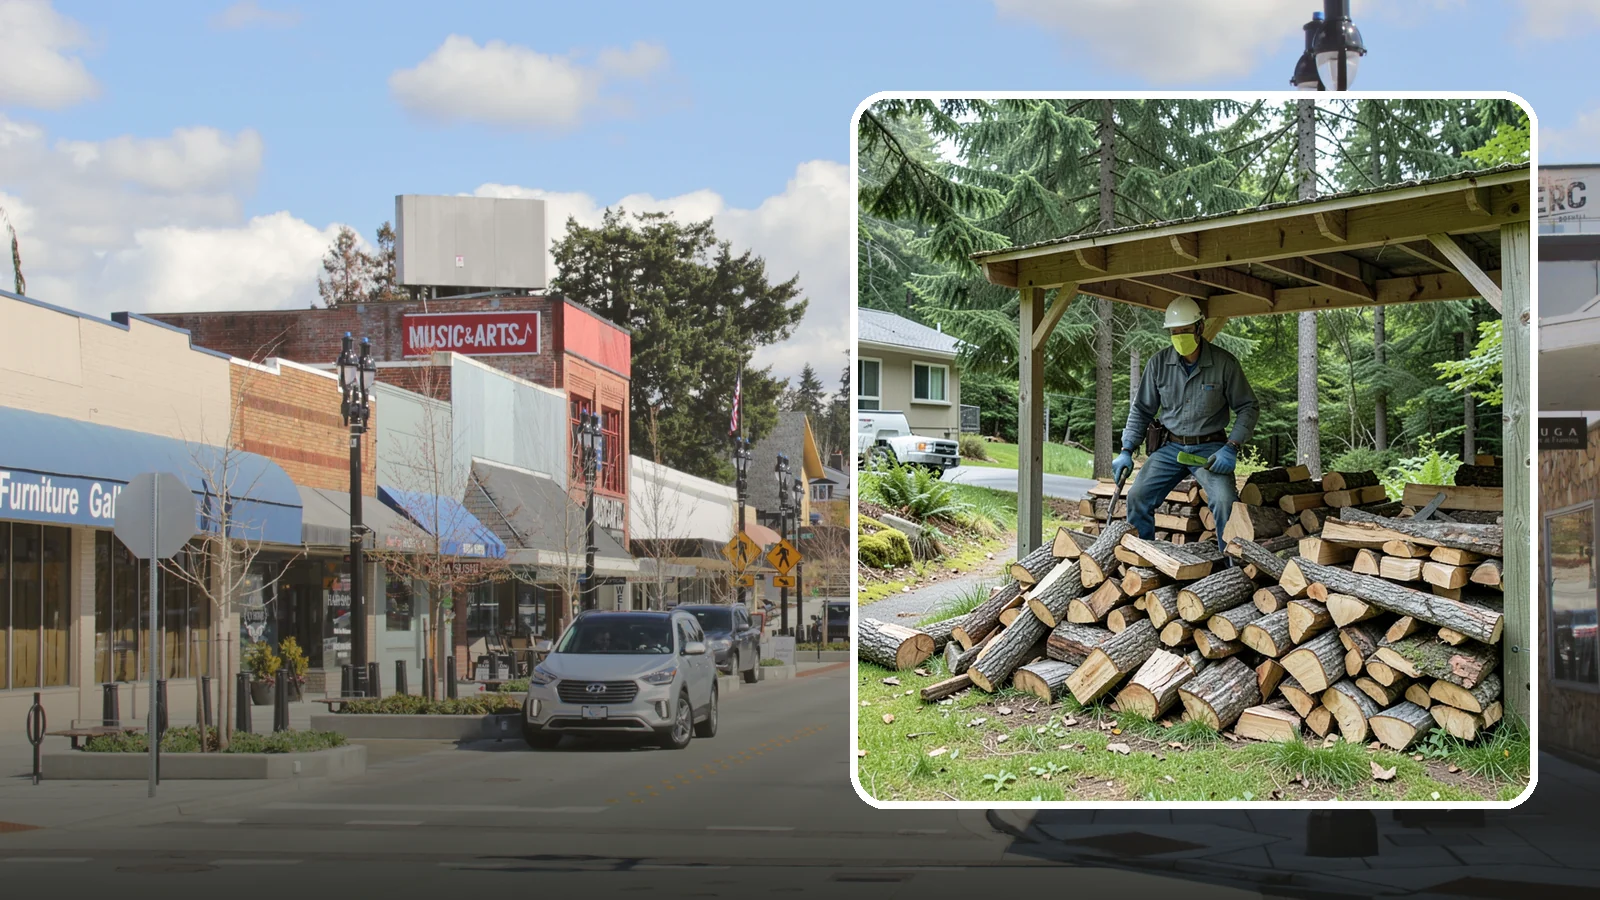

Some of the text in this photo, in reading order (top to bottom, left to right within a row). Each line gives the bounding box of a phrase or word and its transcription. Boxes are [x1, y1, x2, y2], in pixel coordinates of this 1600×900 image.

[409, 323, 519, 348] MUSIC&ARTS
[0, 472, 79, 515] Furniture
[453, 563, 479, 574] SUSHI
